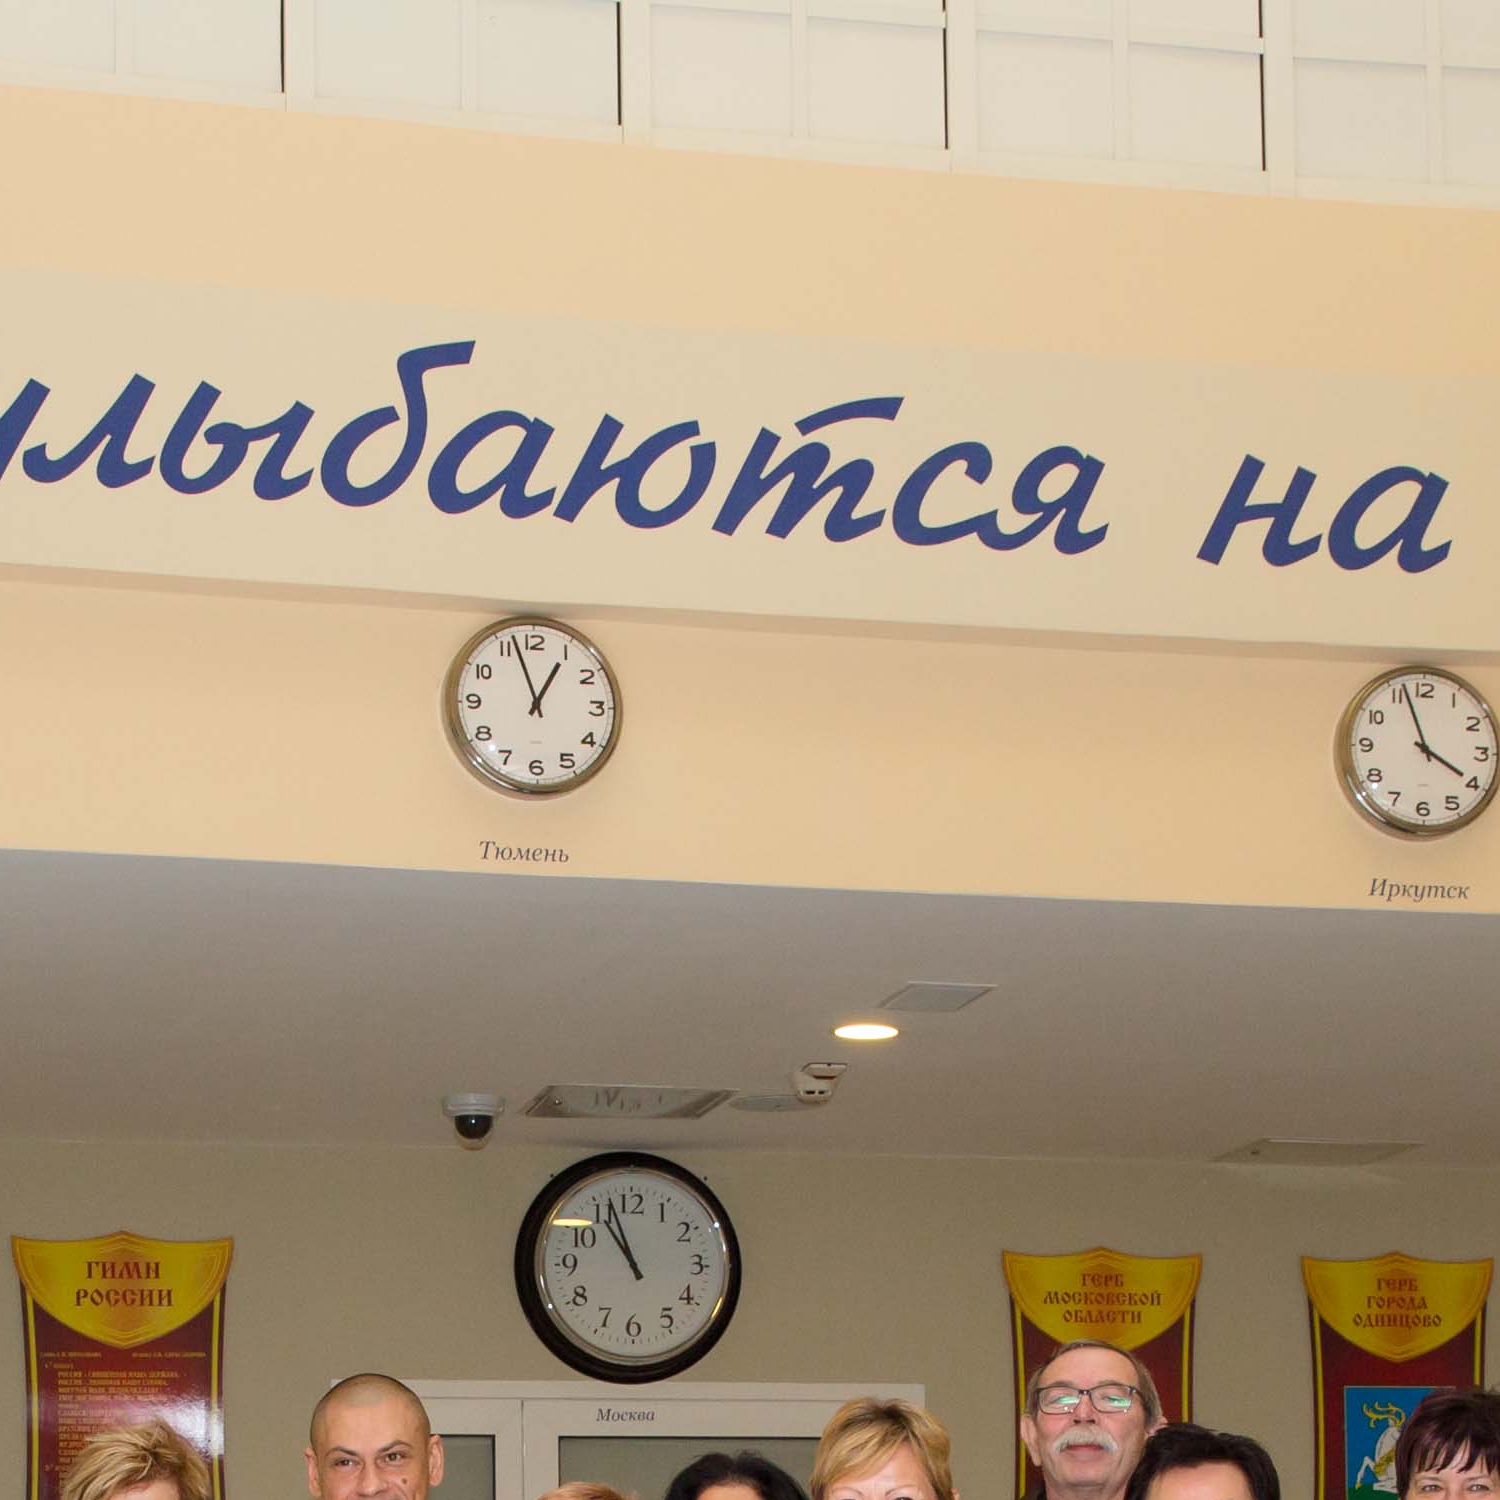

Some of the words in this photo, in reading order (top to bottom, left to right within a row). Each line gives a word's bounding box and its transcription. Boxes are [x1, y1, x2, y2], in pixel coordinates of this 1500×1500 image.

[1198, 454, 1451, 571] на
[500, 640, 511, 657] 11
[525, 634, 545, 651] 12
[564, 644, 568, 661] 1
[476, 663, 492, 680] 10
[579, 669, 595, 685] 2
[1392, 687, 1403, 704] 11
[1415, 682, 1435, 699] 12
[466, 693, 482, 710] 9
[588, 700, 605, 717] 3
[1452, 692, 1456, 708] 1
[1369, 709, 1384, 725] 10
[1466, 716, 1481, 732] 2
[475, 725, 492, 741] 8
[580, 732, 596, 748] 4
[1358, 737, 1374, 753] 9
[498, 750, 512, 766] 7
[559, 753, 576, 769] 5
[1473, 746, 1489, 762] 3
[528, 760, 544, 776] 6
[1366, 768, 1383, 783] 8
[1465, 776, 1480, 791] 4
[1388, 791, 1401, 807] 7
[1444, 795, 1460, 811] 5
[1415, 801, 1430, 817] 6
[479, 840, 570, 864] Тюмень
[1368, 877, 1470, 903] Иркутск
[620, 1193, 644, 1215] 12
[658, 1202, 667, 1223] 1
[594, 1203, 613, 1224] 11
[572, 1227, 596, 1249] 10
[677, 1222, 691, 1242] 2
[85, 1261, 160, 1280] ГИМН
[562, 1253, 578, 1277] 9
[690, 1254, 704, 1276] 3
[1080, 1273, 1125, 1288] ГЕРБ
[1377, 1278, 1419, 1292] ГЕРБ
[75, 1288, 173, 1307] РОССИИ
[572, 1285, 588, 1307] 8
[678, 1283, 694, 1306] 4
[1043, 1290, 1163, 1306] МОСКОВСКОЙ
[1366, 1295, 1429, 1311] ГОРОДА
[598, 1307, 612, 1328] 7
[660, 1307, 674, 1329] 5
[1063, 1309, 1143, 1324] ОБЛАСТИ
[1352, 1312, 1443, 1331] ОДИНЦОВО
[625, 1313, 642, 1338] 6
[596, 1407, 655, 1422] Москва
